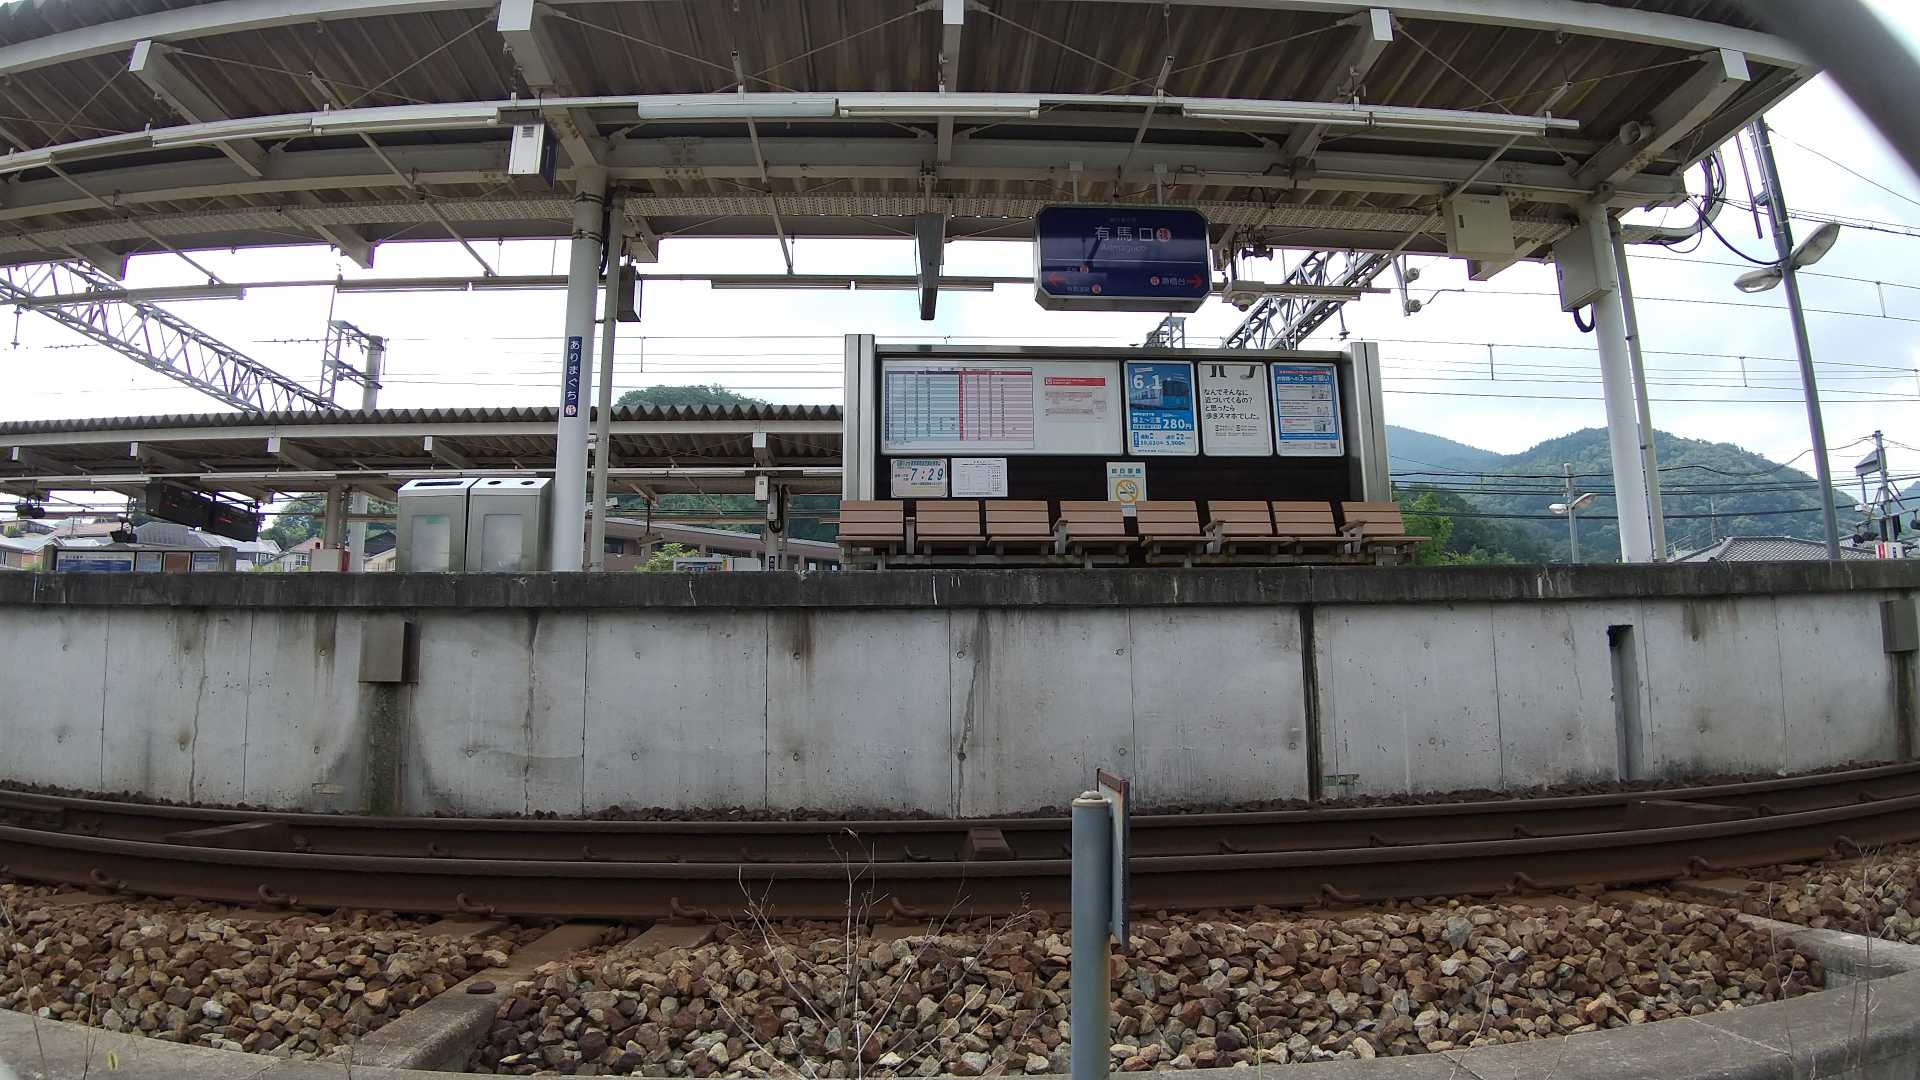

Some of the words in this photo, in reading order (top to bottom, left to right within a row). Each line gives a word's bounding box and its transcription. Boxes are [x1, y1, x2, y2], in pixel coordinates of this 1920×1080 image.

[1095, 226, 1154, 242] 有馬口
[568, 341, 580, 401] ありまぐち
[1133, 374, 1162, 394] 6.1
[1204, 388, 1249, 396] なんでそんなに
[1205, 404, 1236, 412] と思ったら
[1162, 418, 1192, 430] 280円
